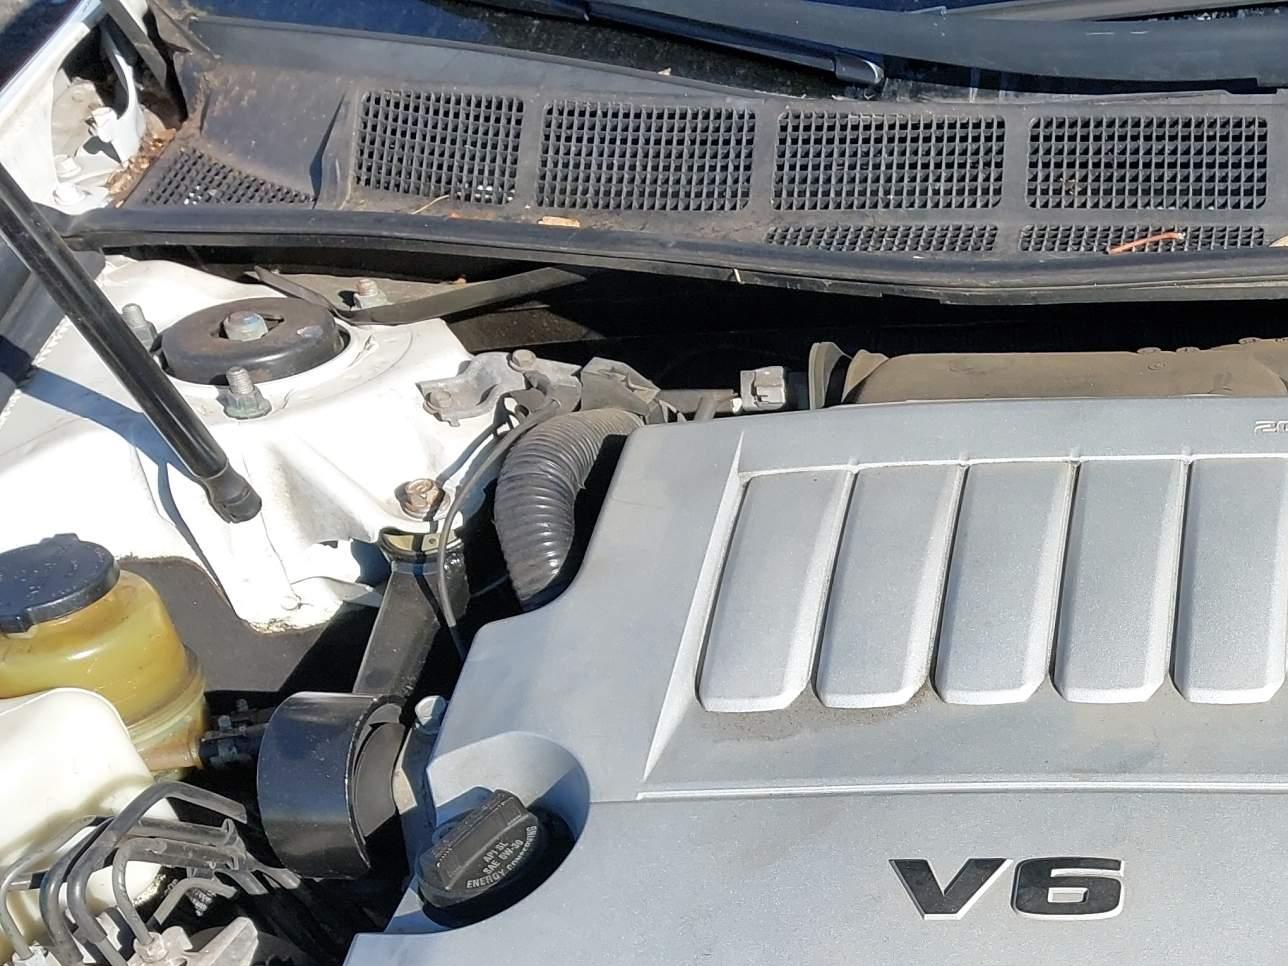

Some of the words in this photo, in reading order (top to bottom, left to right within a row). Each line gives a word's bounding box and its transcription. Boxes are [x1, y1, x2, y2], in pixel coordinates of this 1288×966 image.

[483, 849, 499, 863] API
[482, 859, 501, 875] SAE
[466, 868, 505, 889] ENERGY
[888, 856, 1125, 921] V6
